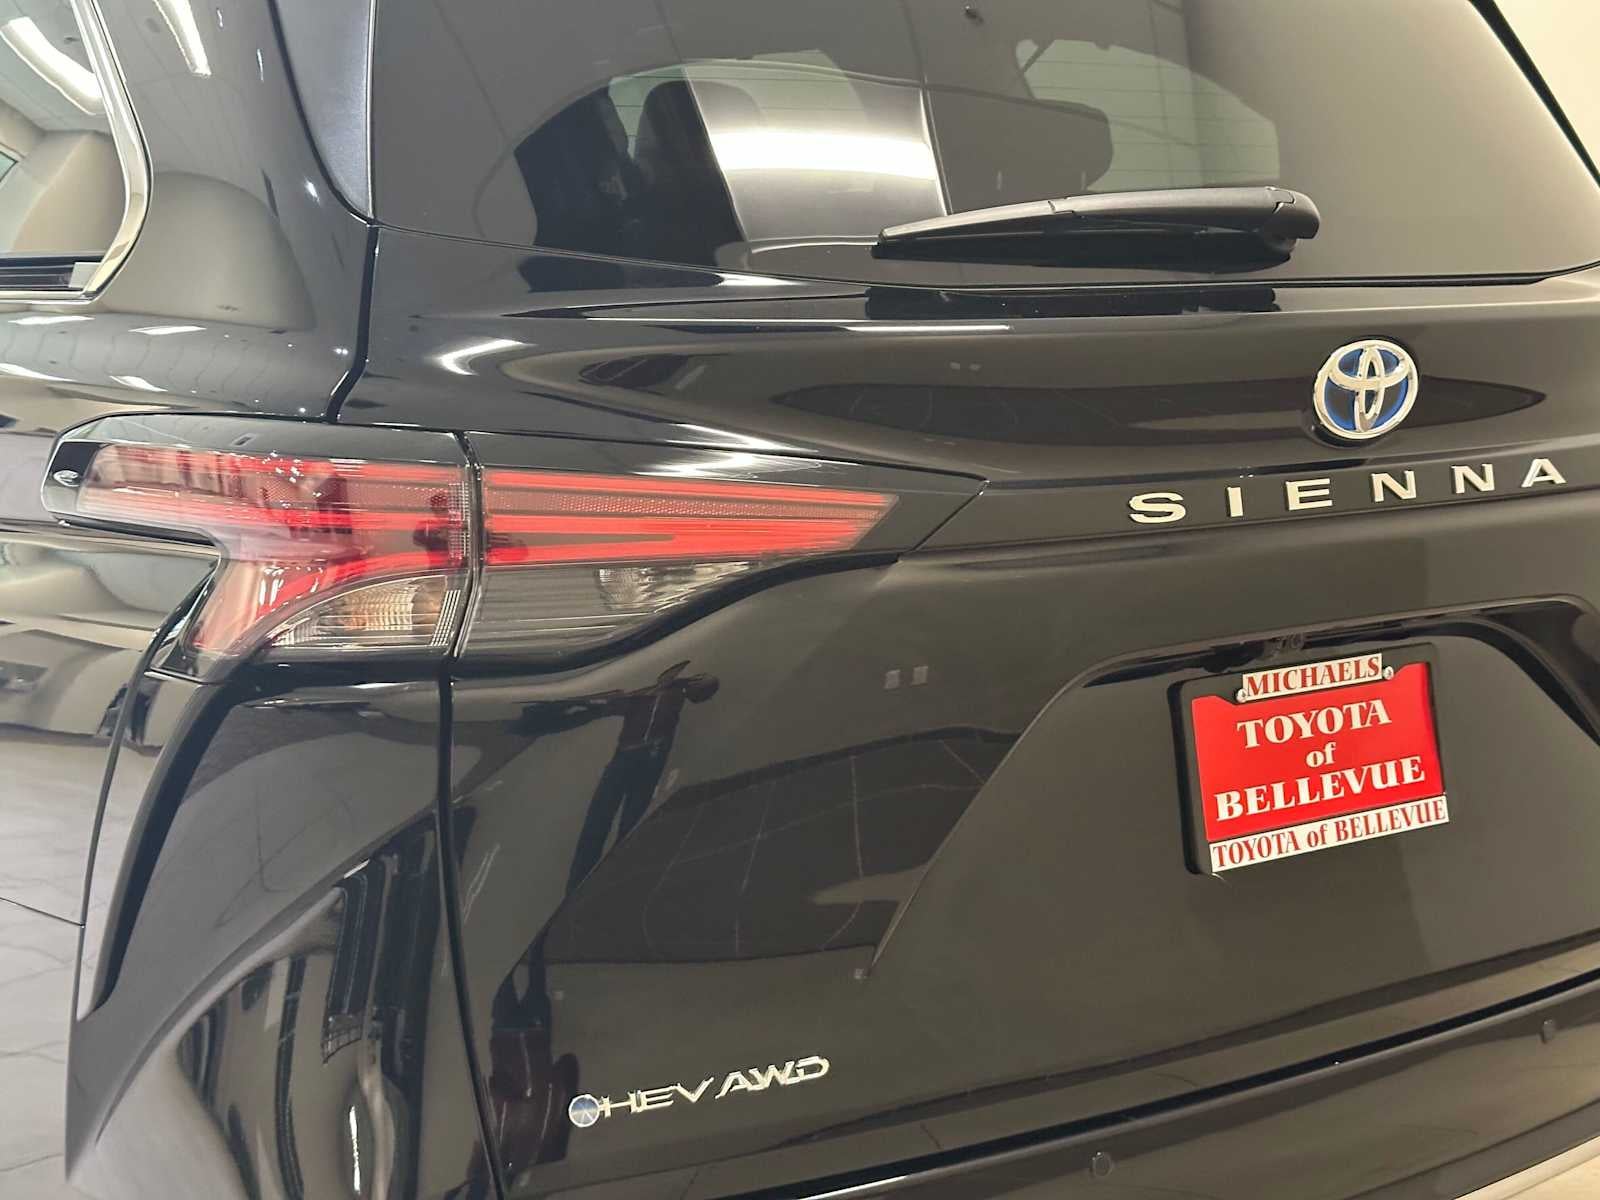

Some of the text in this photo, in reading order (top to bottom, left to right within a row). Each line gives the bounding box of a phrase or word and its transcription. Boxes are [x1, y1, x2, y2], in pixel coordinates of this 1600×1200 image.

[1129, 458, 1567, 524] SIENNA
[1246, 656, 1380, 697] MICHAELS
[1236, 699, 1392, 749] TOYOTA
[1305, 742, 1336, 767] of
[1214, 755, 1425, 822] BELLEVUE
[1212, 799, 1446, 868] TOYOTA of BELLEVUE
[599, 1055, 830, 1118] HEV AWD
